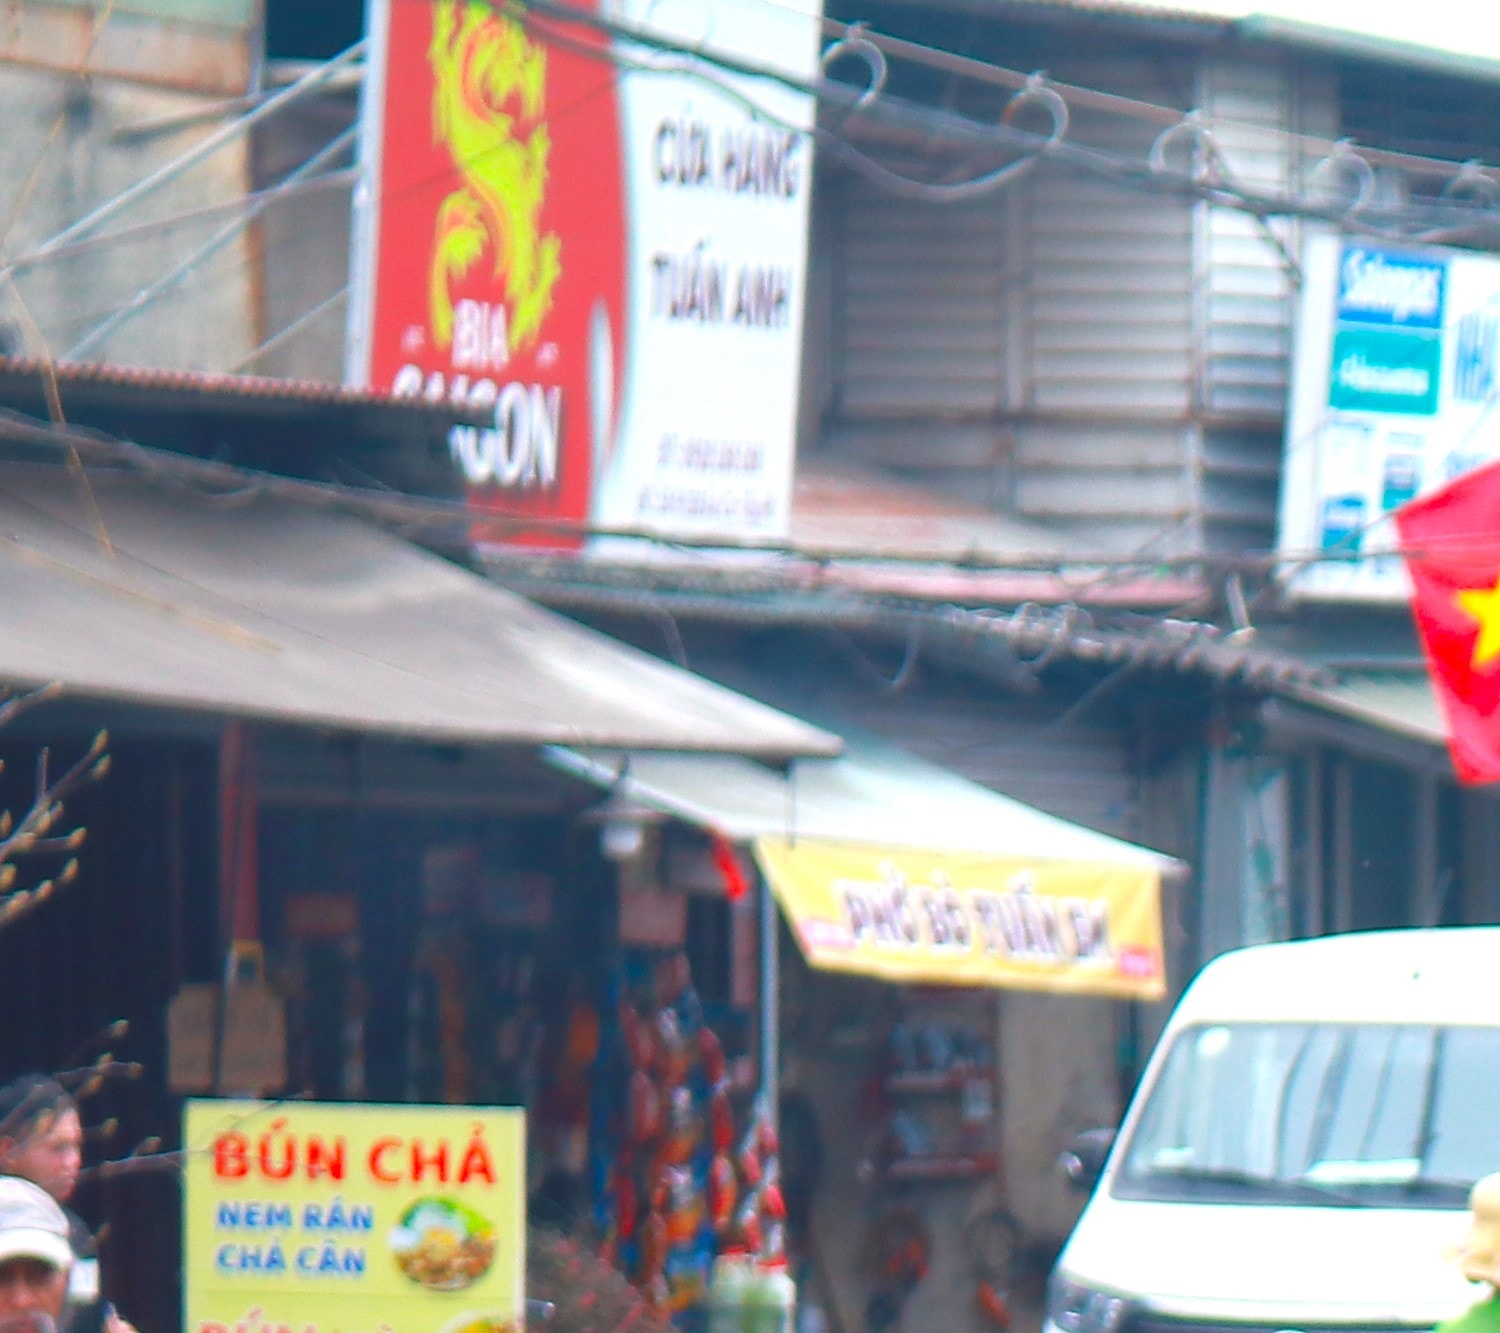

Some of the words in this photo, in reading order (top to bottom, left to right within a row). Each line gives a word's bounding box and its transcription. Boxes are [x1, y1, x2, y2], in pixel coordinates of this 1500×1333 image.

[452, 298, 510, 371] BIA
[212, 1117, 347, 1182] BÚN
[367, 1122, 497, 1185] CHẢ
[216, 1200, 293, 1229] NEM
[302, 1195, 373, 1230] RÁN
